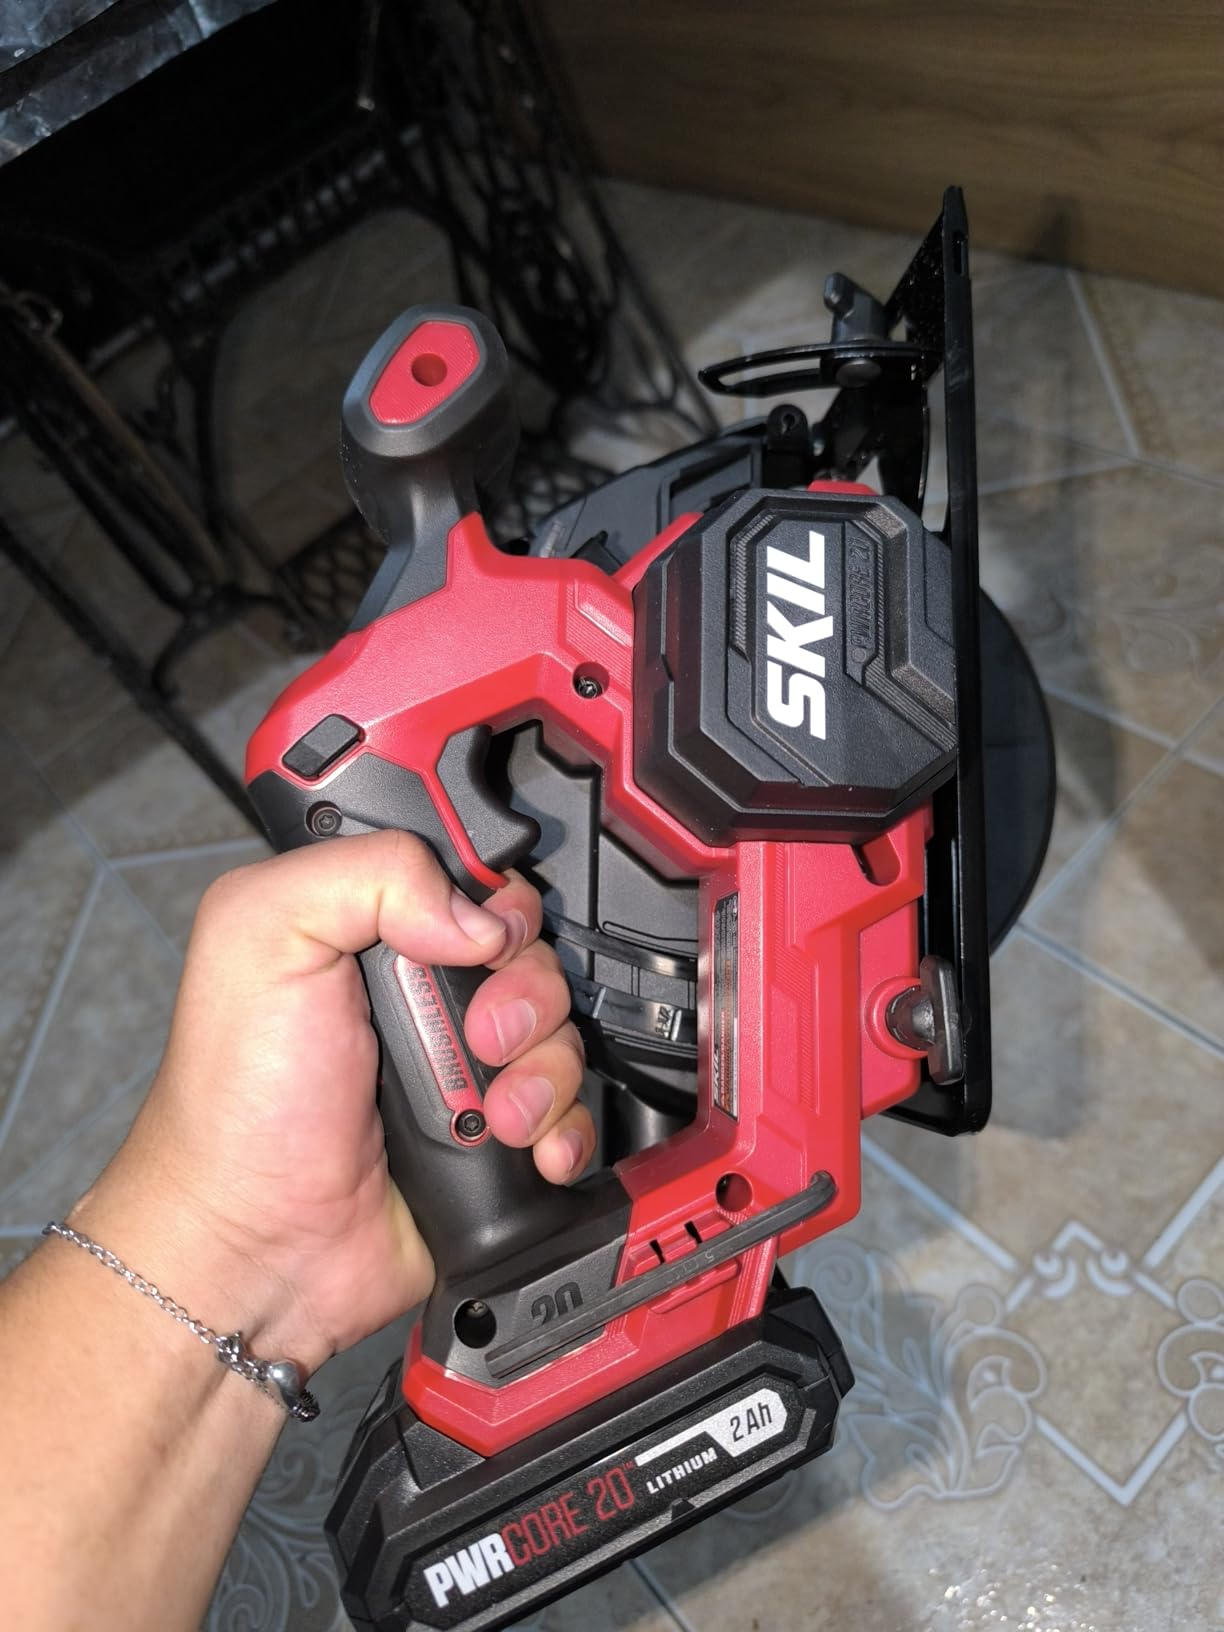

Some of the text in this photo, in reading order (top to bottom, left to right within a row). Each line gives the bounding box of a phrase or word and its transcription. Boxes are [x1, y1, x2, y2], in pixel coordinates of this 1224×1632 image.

[767, 530, 834, 740] SKIL
[646, 1447, 718, 1494] LITHIUM
[423, 1491, 589, 1608] PWRCORE
